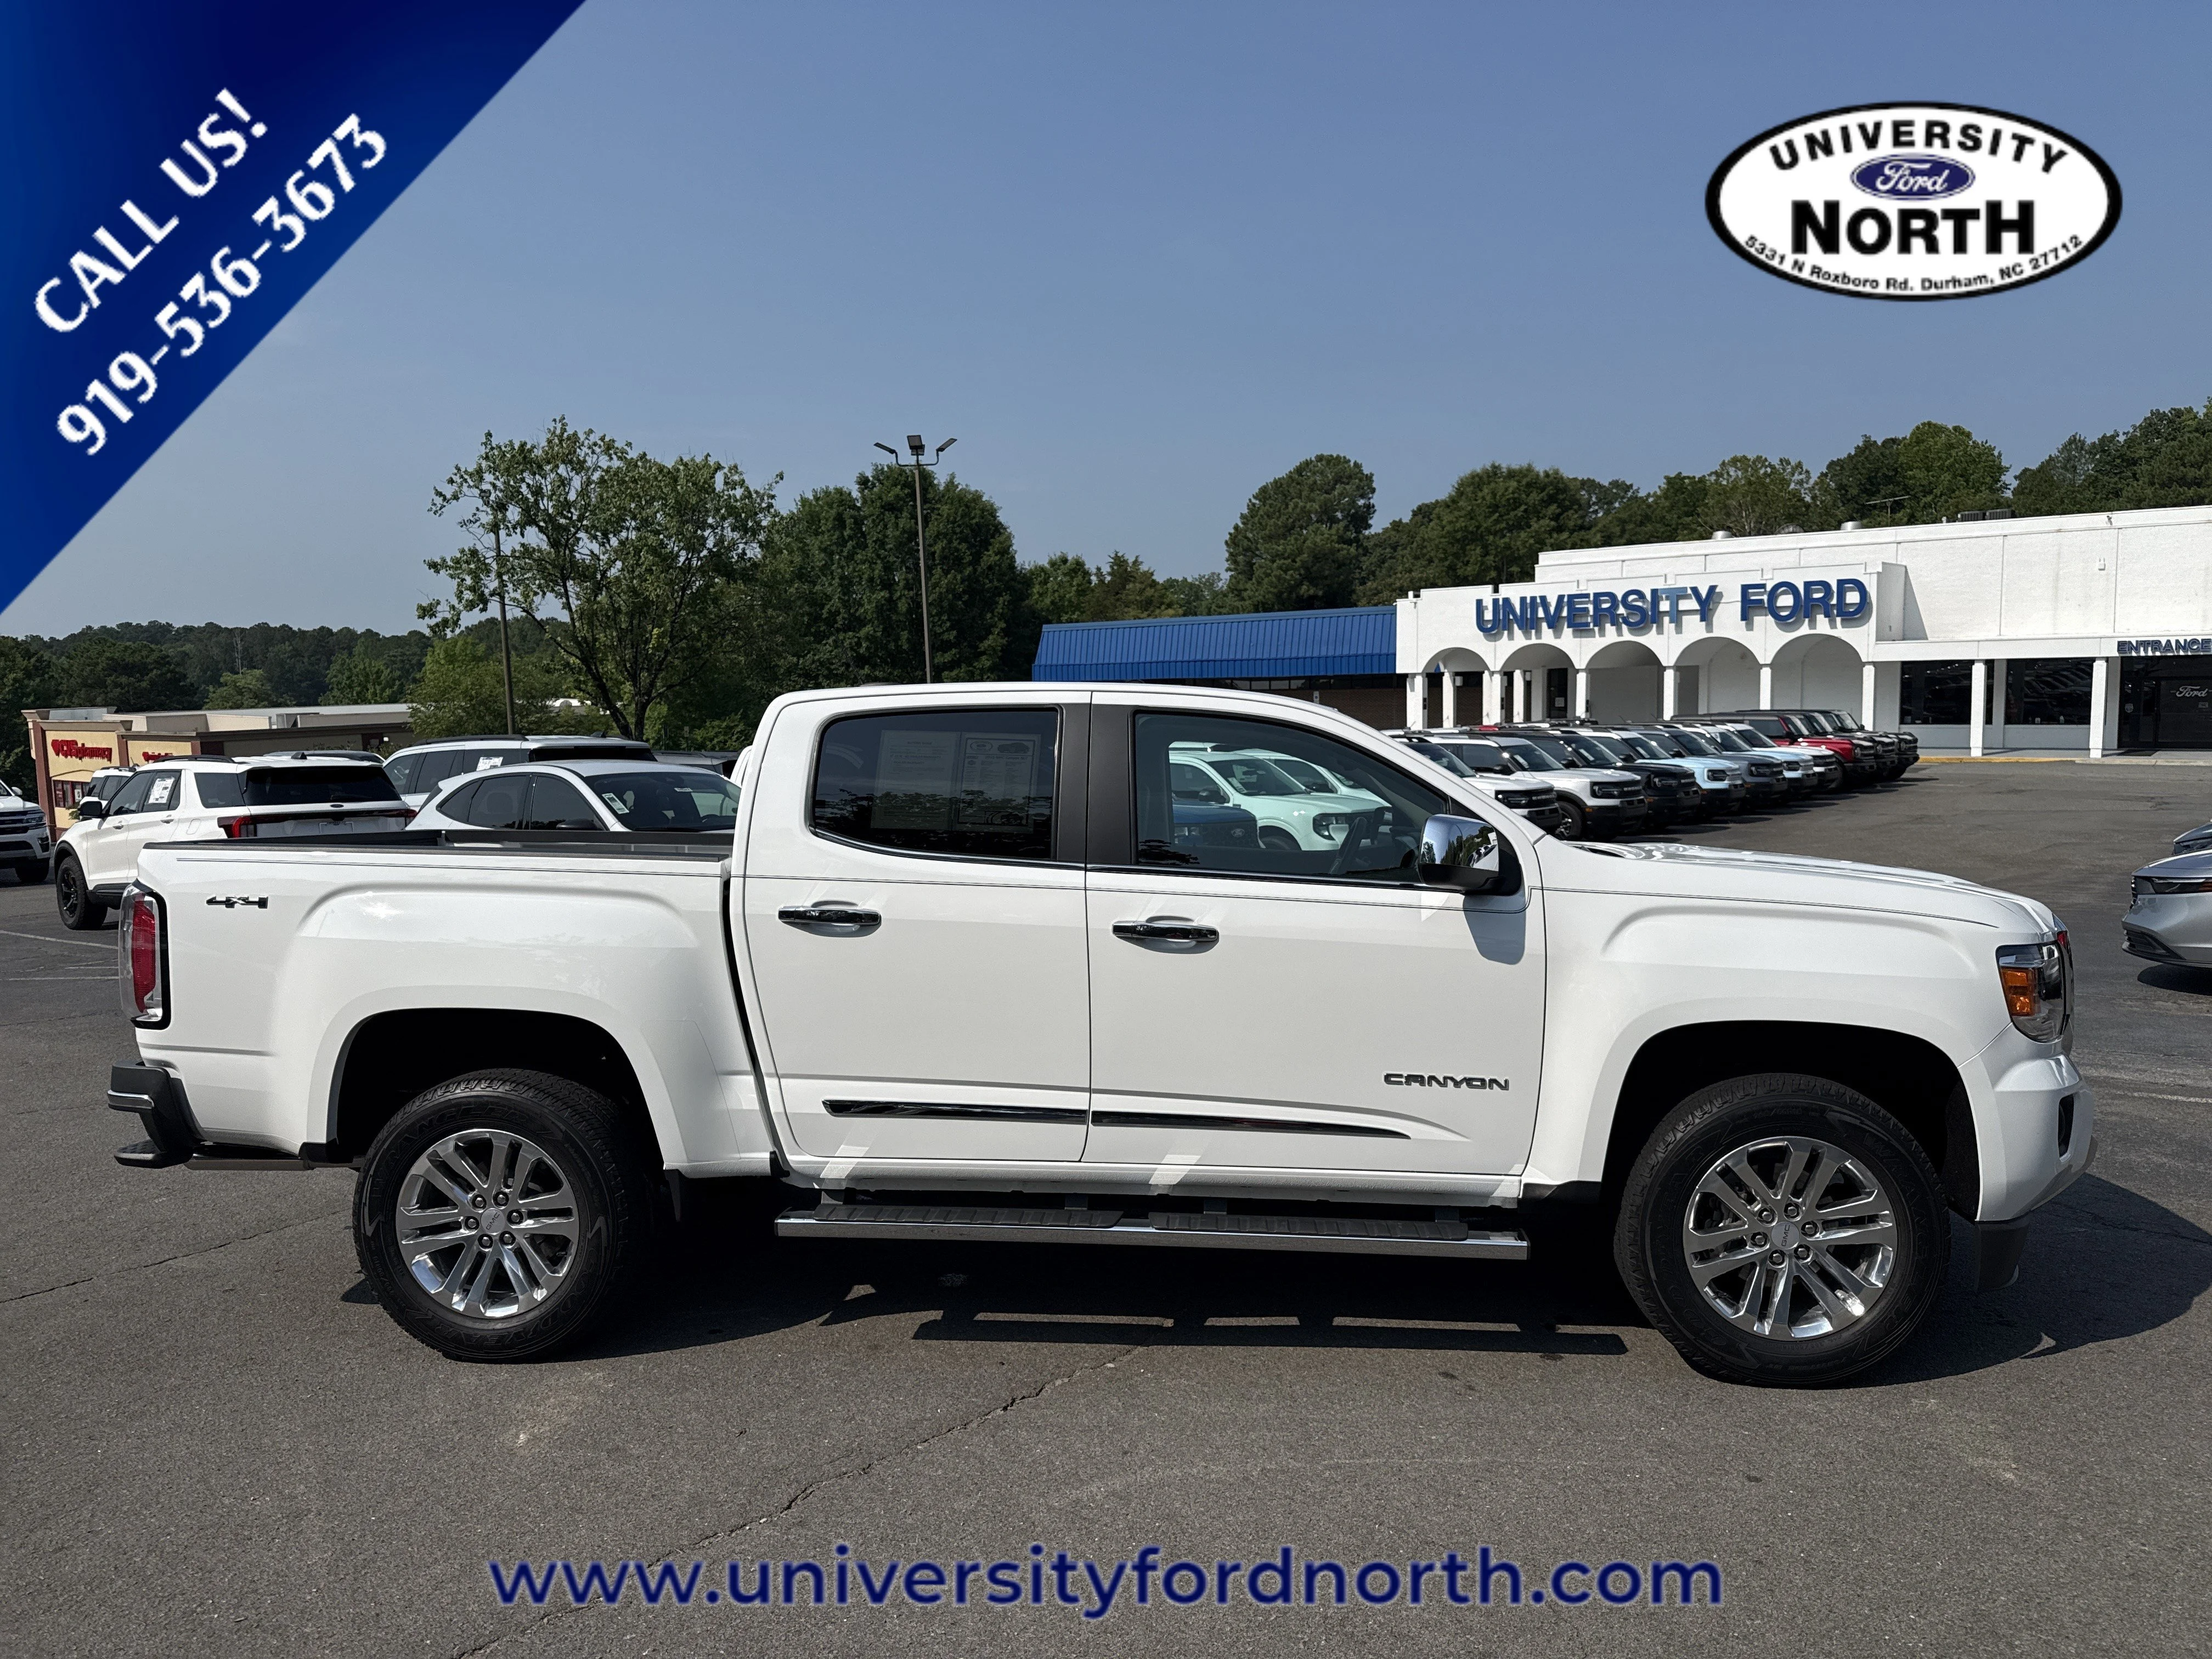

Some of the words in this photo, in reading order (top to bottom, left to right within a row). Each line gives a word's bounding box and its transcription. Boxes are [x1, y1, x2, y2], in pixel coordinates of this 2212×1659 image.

[1475, 584, 1718, 634] UNIVERSITY
[1740, 578, 1867, 622] FORD
[2117, 638, 2212, 653] ENTRANCE
[2175, 686, 2208, 697] Ford
[1384, 1073, 1509, 1091] CANYON
[486, 1212, 500, 1230] GMC
[1781, 1224, 1790, 1246] GMC
